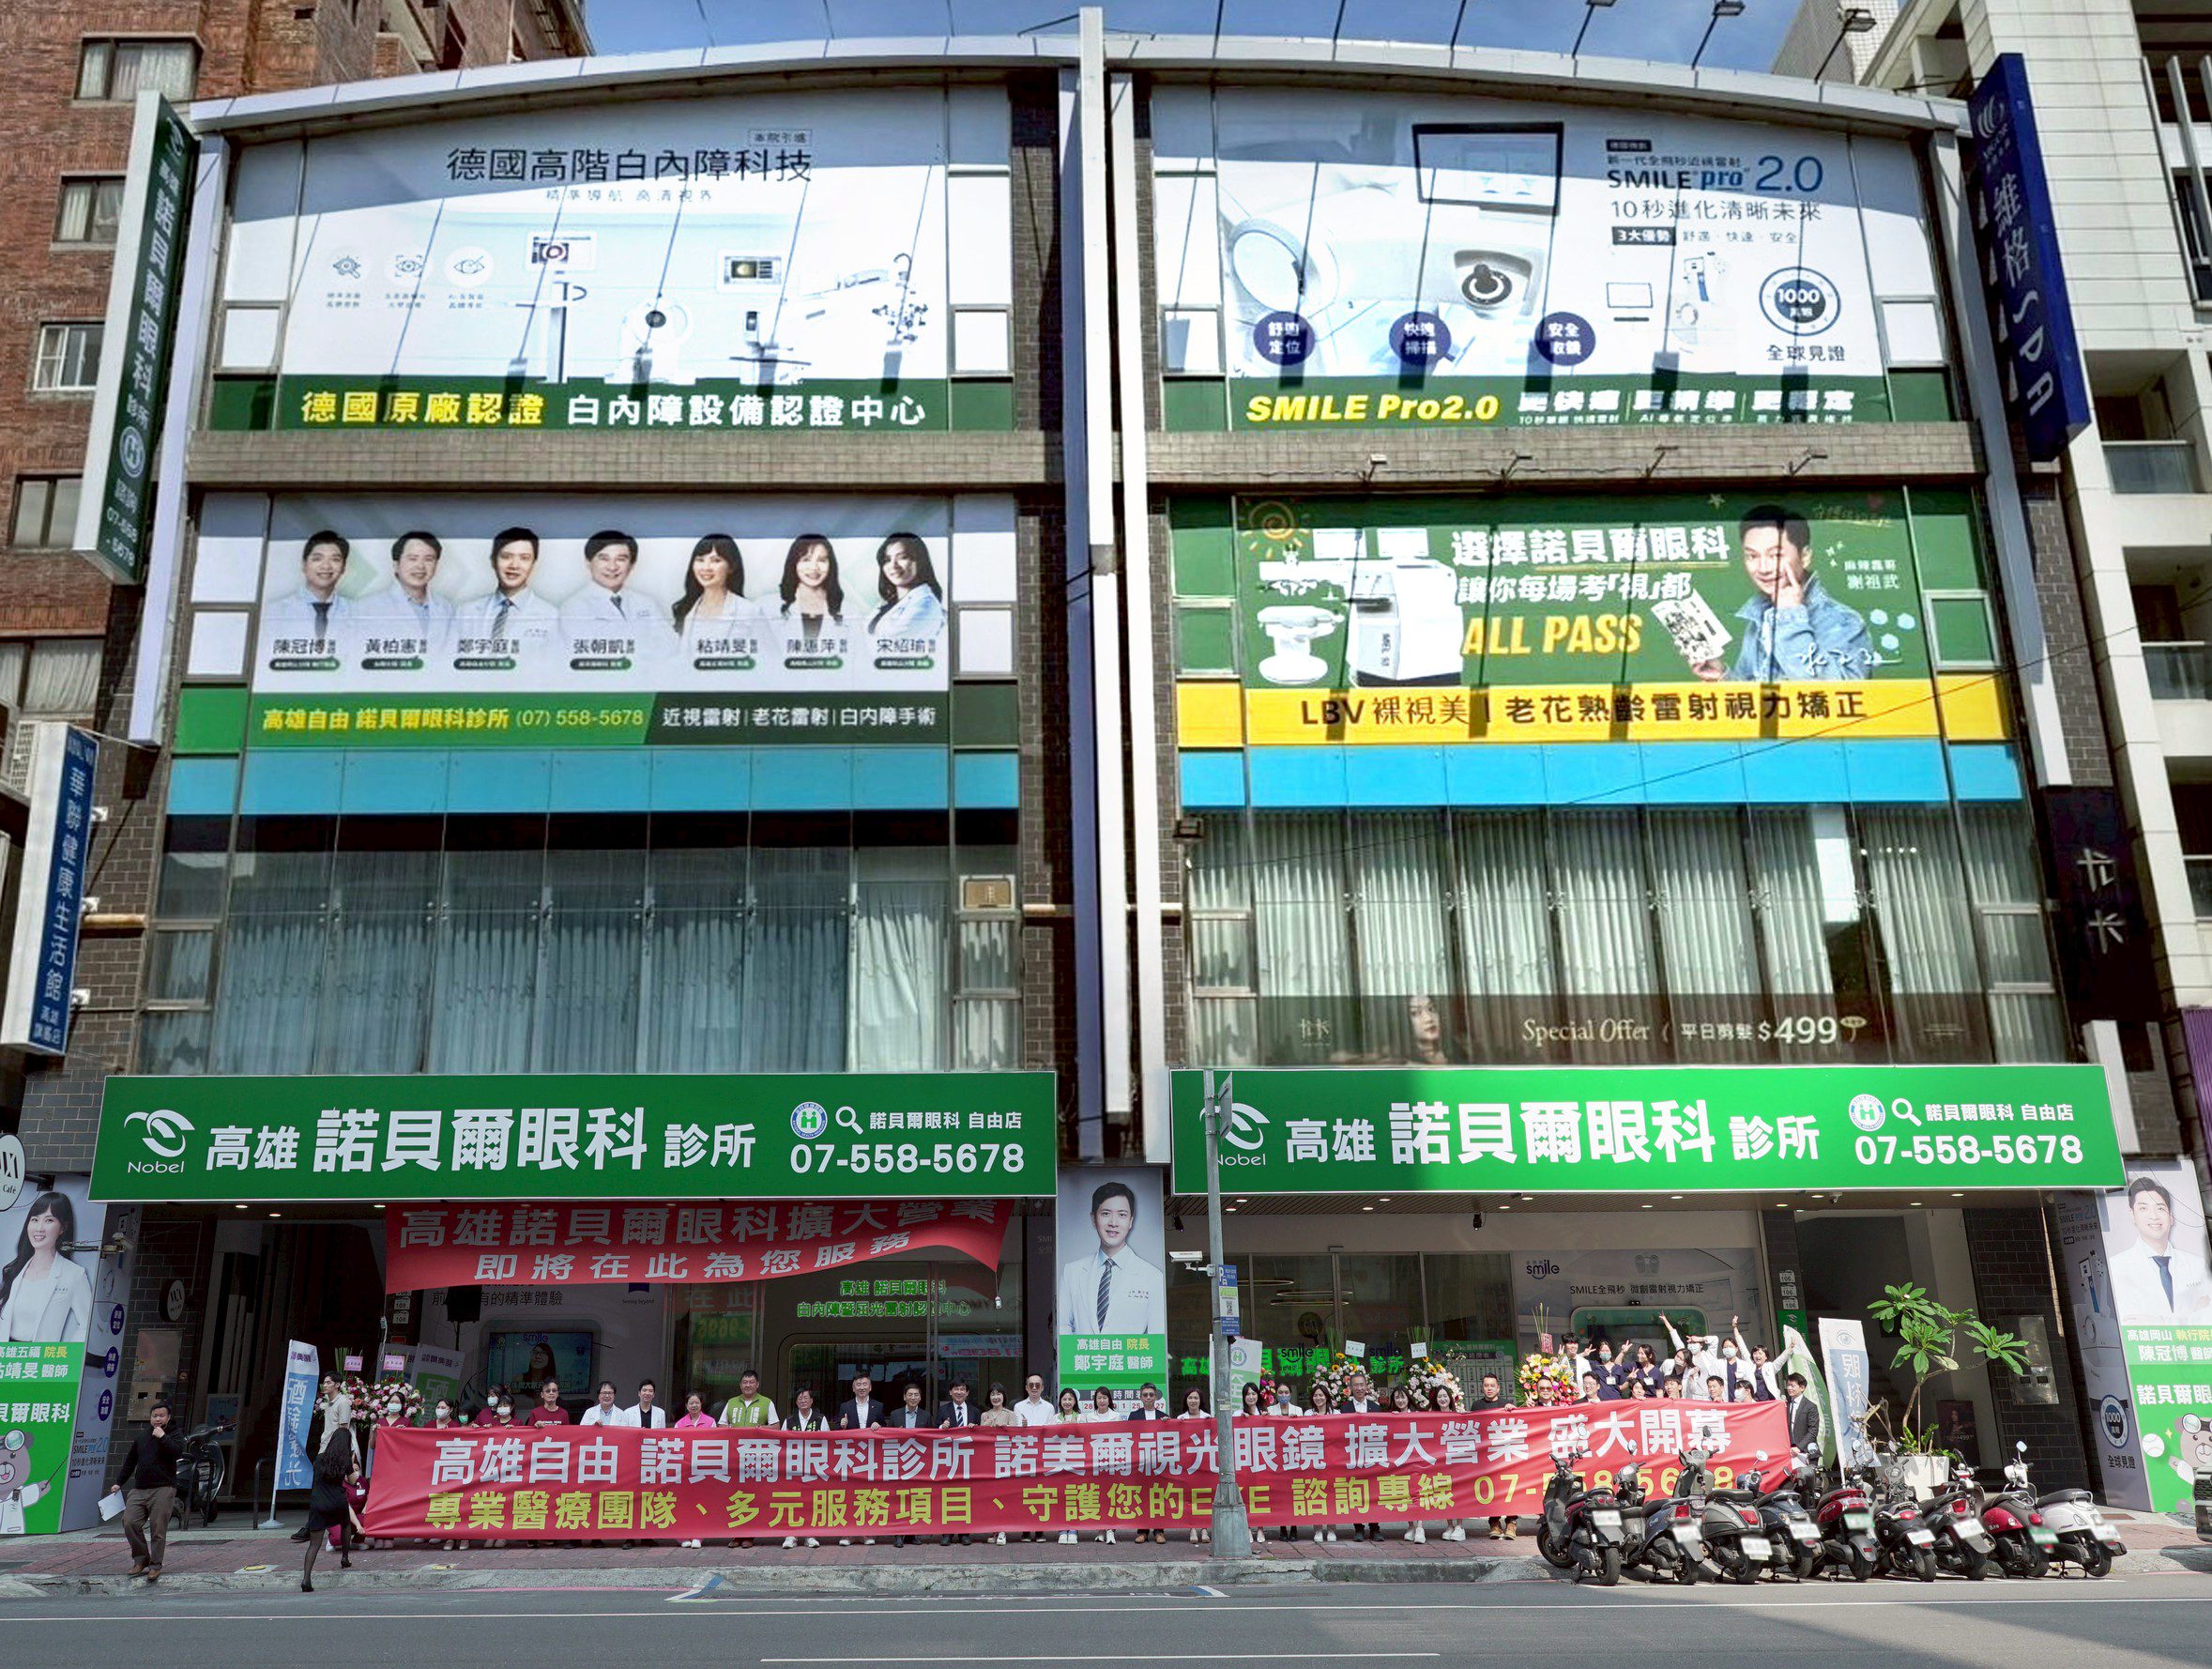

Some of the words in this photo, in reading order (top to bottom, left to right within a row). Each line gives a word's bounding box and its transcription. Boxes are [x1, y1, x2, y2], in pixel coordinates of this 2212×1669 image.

[447, 147, 811, 182] 德國高階白內障科技
[1608, 170, 1691, 190] SMILE
[1701, 170, 1744, 191] pro
[1755, 156, 1823, 192] 2.0
[1610, 200, 1823, 222] 10秒進化清晰未來
[1777, 288, 1821, 303] 1000
[1404, 322, 1436, 337] 快速
[1548, 322, 1580, 338] 安全
[1269, 340, 1301, 355] 定位
[1766, 345, 1846, 362] 全球見證
[301, 391, 545, 424] 德國原廠認證
[568, 394, 925, 426] 白內障設備認證中心
[1246, 395, 1368, 421] SMILE
[1378, 395, 1500, 421] Pro2.0
[1451, 526, 1730, 566] 選擇諾貝爾眼科
[1457, 572, 1692, 605] 讓你每場考「視」都
[1461, 615, 1531, 655] ALL
[1543, 613, 1643, 654] PASS
[662, 708, 740, 728] 近視雷射
[752, 708, 830, 727] 老花雷射
[840, 708, 937, 727] 白內障手術
[1302, 700, 1365, 726] LBV
[1373, 696, 1470, 726] 裸視美
[1505, 690, 1868, 726] 老花熟齡雷射視力矯正
[263, 709, 350, 730] 高雄自由
[356, 709, 510, 730] 諾貝爾眼科診所
[516, 710, 551, 729] (07)
[556, 709, 644, 726] 558-5678
[1522, 1018, 1594, 1049] Special
[1599, 1018, 1651, 1044] Offer
[1757, 1015, 1838, 1046] $499
[869, 1111, 960, 1130] 諾貝爾眼科
[968, 1111, 1023, 1130] 自由店
[1925, 1103, 2015, 1123] 諾貝爾眼科
[2021, 1103, 2075, 1122] 自由店
[205, 1125, 300, 1171] 高雄
[312, 1106, 648, 1173] 諾貝爾眼科
[664, 1123, 756, 1170] 診所
[1285, 1117, 1378, 1164] 高雄
[1389, 1099, 1716, 1165] 諾貝爾眼科
[1729, 1114, 1821, 1161] 診所
[789, 1142, 1026, 1174] 07-558-5678
[1854, 1135, 2084, 1166] 07-558-5678
[127, 1159, 185, 1174] Nobel
[399, 1198, 999, 1248] 高雄諾貝爾眼科擴大營業
[473, 1229, 911, 1281] 即將在此為您服務
[1526, 1259, 1560, 1275] smile
[839, 1279, 871, 1296] 高雄
[1569, 1284, 1625, 1294] SMILE全飛秒
[432, 1291, 563, 1306] 前有的精準體驗
[1076, 1339, 1123, 1351] 高雄自由
[1126, 1339, 1150, 1351] 院長
[2127, 1329, 2173, 1341] 高雄岡山
[2174, 1329, 2212, 1341] 執行院
[43, 1345, 69, 1358] 院長
[2138, 1344, 2189, 1361] 陳冠博
[41, 1364, 69, 1378] 醫師
[1074, 1355, 1124, 1371] 鄭宇庭
[1127, 1355, 1153, 1370] 醫師
[2136, 1384, 2212, 1405] 諾貝爾眼
[431, 1436, 619, 1486] 高雄自由
[640, 1436, 975, 1484] 諾貝爾眼科診所
[994, 1424, 1326, 1478] 諾美爾視光眼鏡
[1345, 1417, 1531, 1469] 擴大營業
[1548, 1408, 1732, 1459] 盛大開幕
[425, 1482, 1272, 1530] 專業醫療團隊、多元服務項目、守護您的EE
[1291, 1471, 1456, 1518] 諮詢專線
